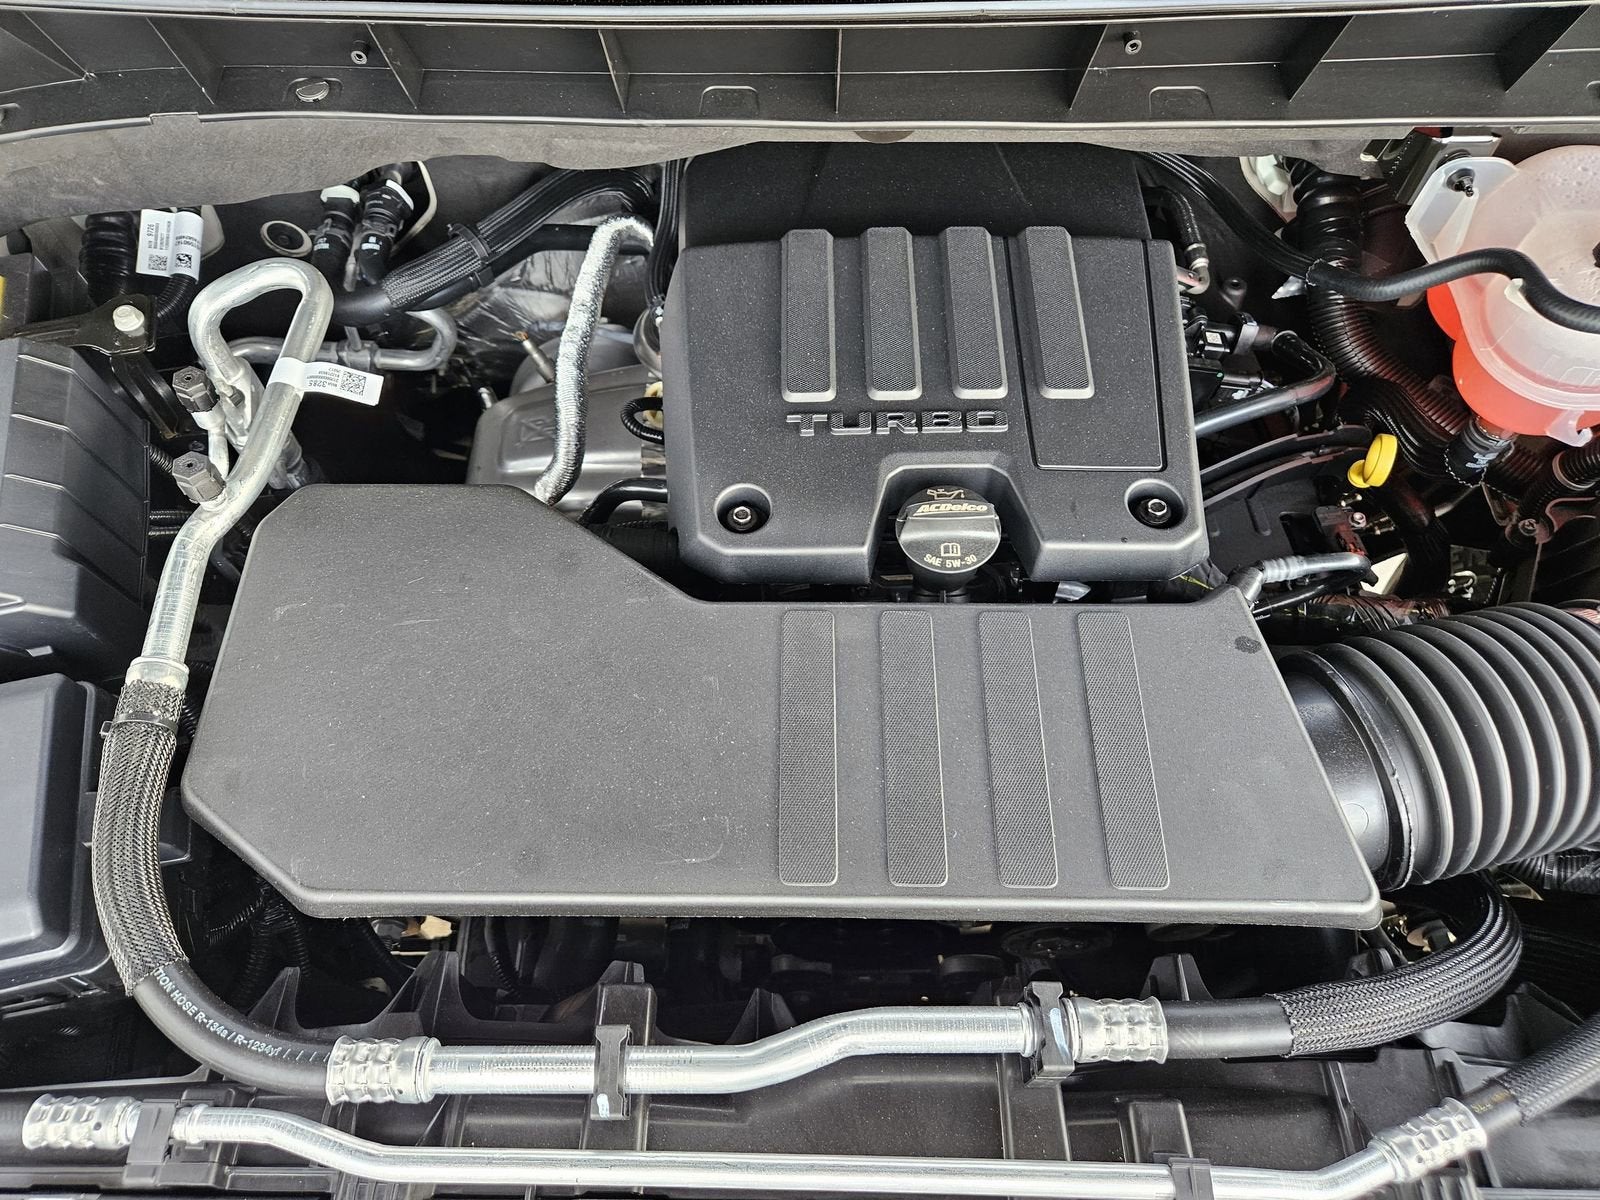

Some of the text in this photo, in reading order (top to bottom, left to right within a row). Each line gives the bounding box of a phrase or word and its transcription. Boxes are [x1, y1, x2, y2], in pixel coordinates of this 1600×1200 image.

[308, 379, 327, 388] 3285
[786, 411, 1008, 436] TURBO
[914, 503, 988, 514] ACDelco
[923, 553, 977, 568] SAE 5W-30
[170, 989, 198, 1016] HOSE
[194, 1011, 228, 1038] R-134a
[234, 1034, 282, 1057] R-1234yf
